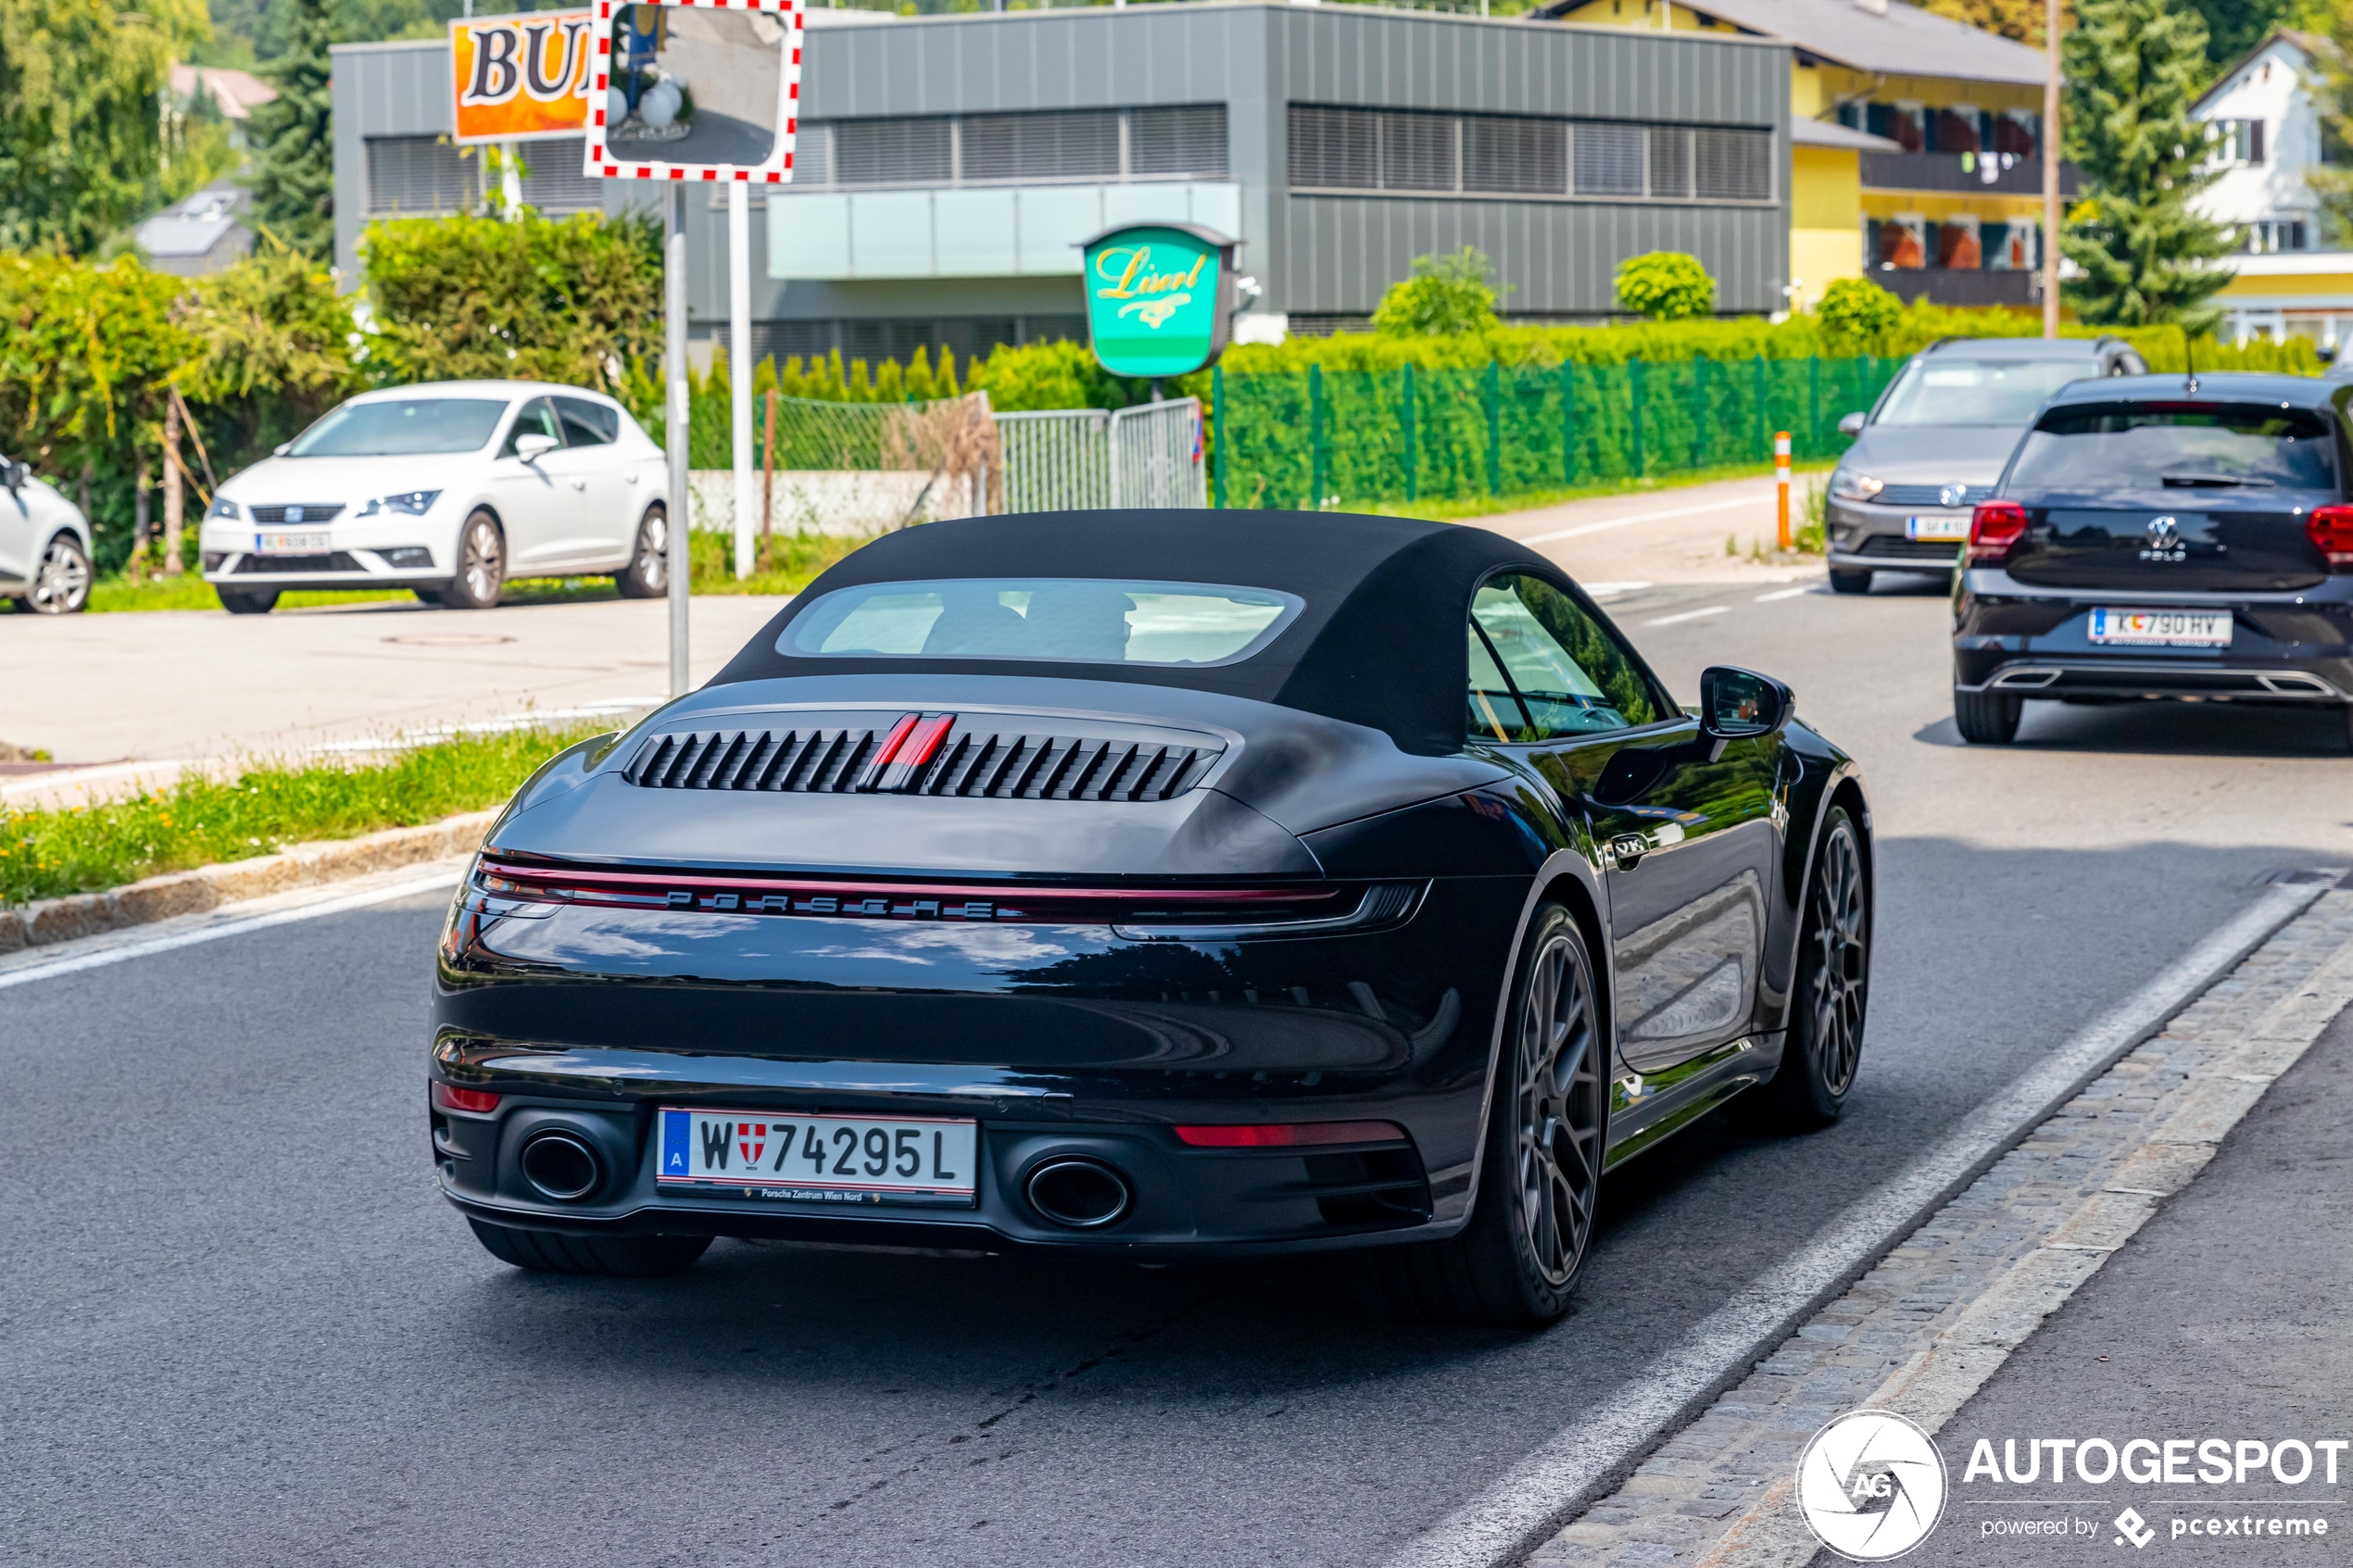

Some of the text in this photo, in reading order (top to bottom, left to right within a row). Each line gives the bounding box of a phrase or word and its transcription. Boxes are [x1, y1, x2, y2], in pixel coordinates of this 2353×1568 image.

[467, 23, 591, 98] BU
[2118, 614, 2129, 633] K
[666, 891, 994, 918] PORSCHE
[701, 1121, 733, 1170] W
[671, 1152, 683, 1167] A
[761, 1188, 862, 1202] Porsche Zentrum Wien Nord
